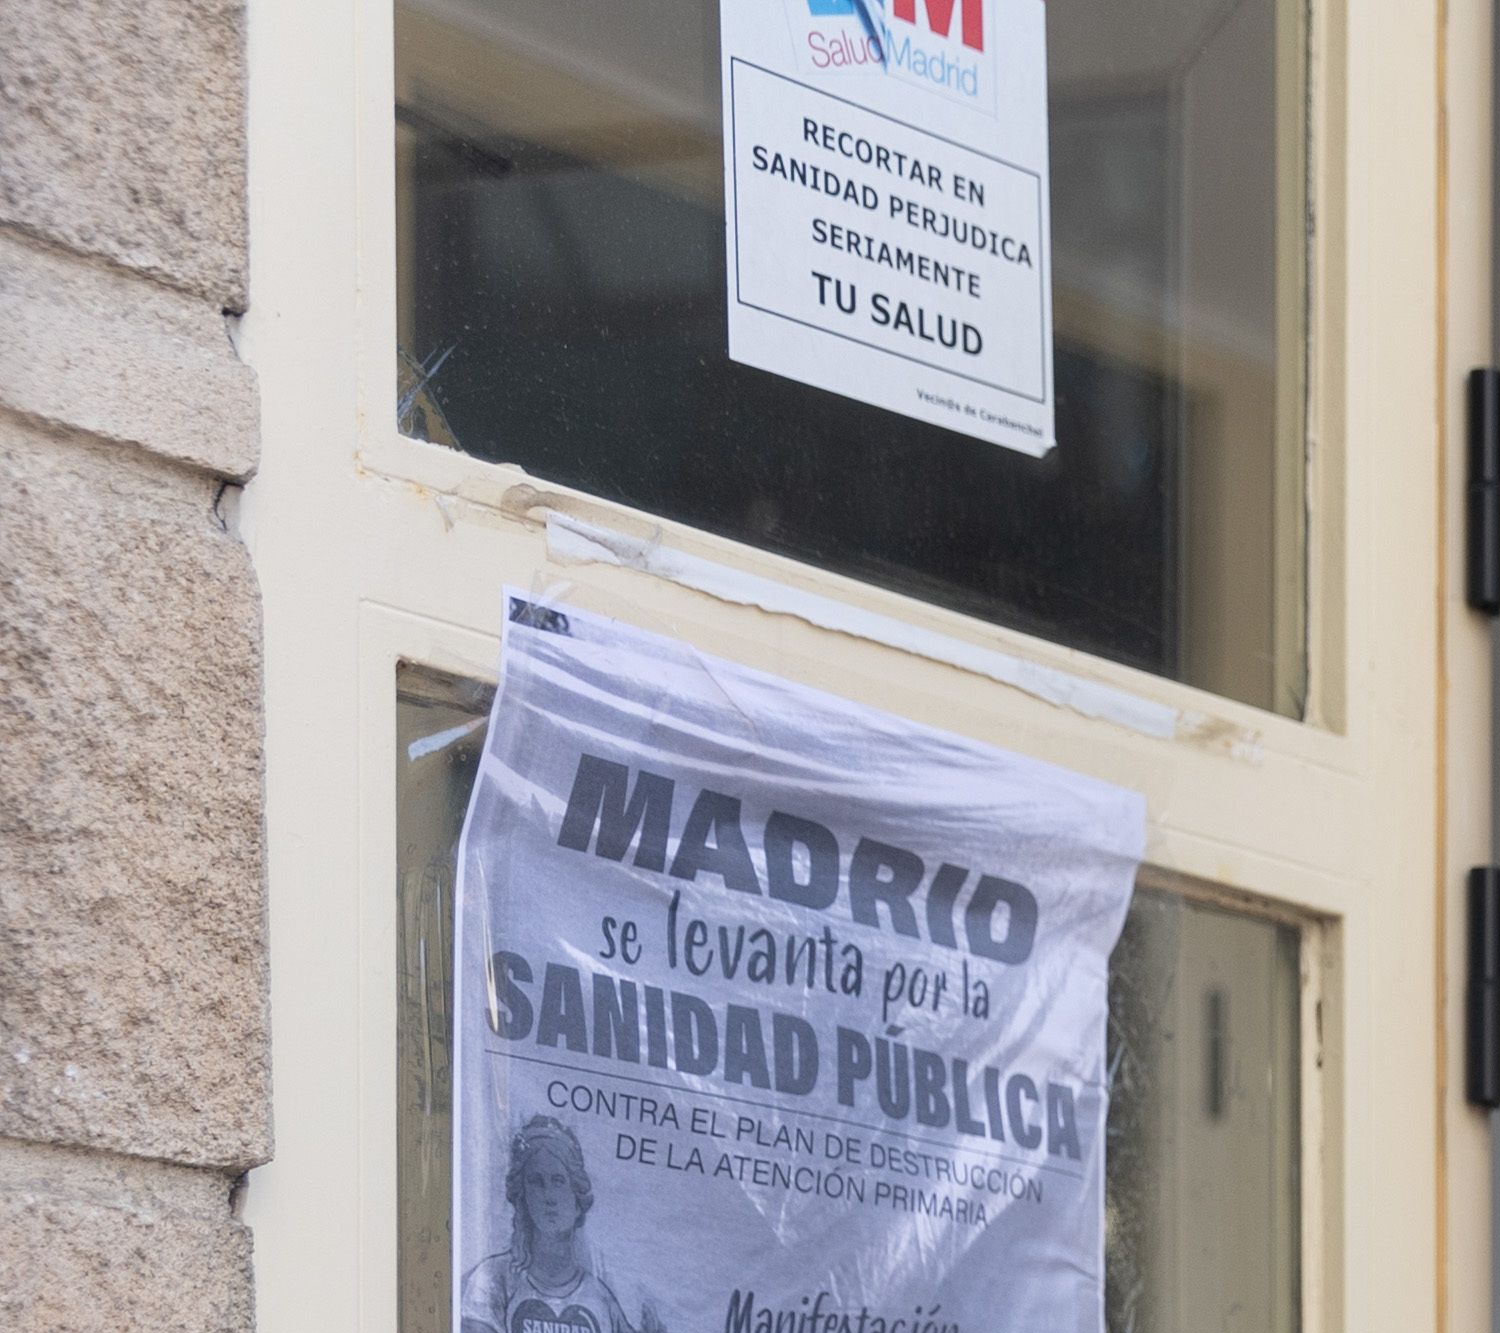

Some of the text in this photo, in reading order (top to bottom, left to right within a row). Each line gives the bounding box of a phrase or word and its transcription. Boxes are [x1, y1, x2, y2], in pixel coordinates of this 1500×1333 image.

[752, 145, 1032, 268] SANIDAD PERJUDICA
[803, 117, 985, 207] RECORTAR EN
[811, 219, 980, 298] SERIAMENTE
[811, 271, 983, 356] TU SALUD
[963, 403, 976, 416] de
[557, 753, 1038, 966] MADRID
[599, 890, 990, 1023] se levanta por la
[486, 951, 1081, 1160] SANIDAD PÚBLICA
[546, 1081, 1043, 1203] CONTRA EL PLAN DE DESTRUCCIÓN
[616, 1135, 987, 1226] DE LA ATENCIÓN PRIMARIA
